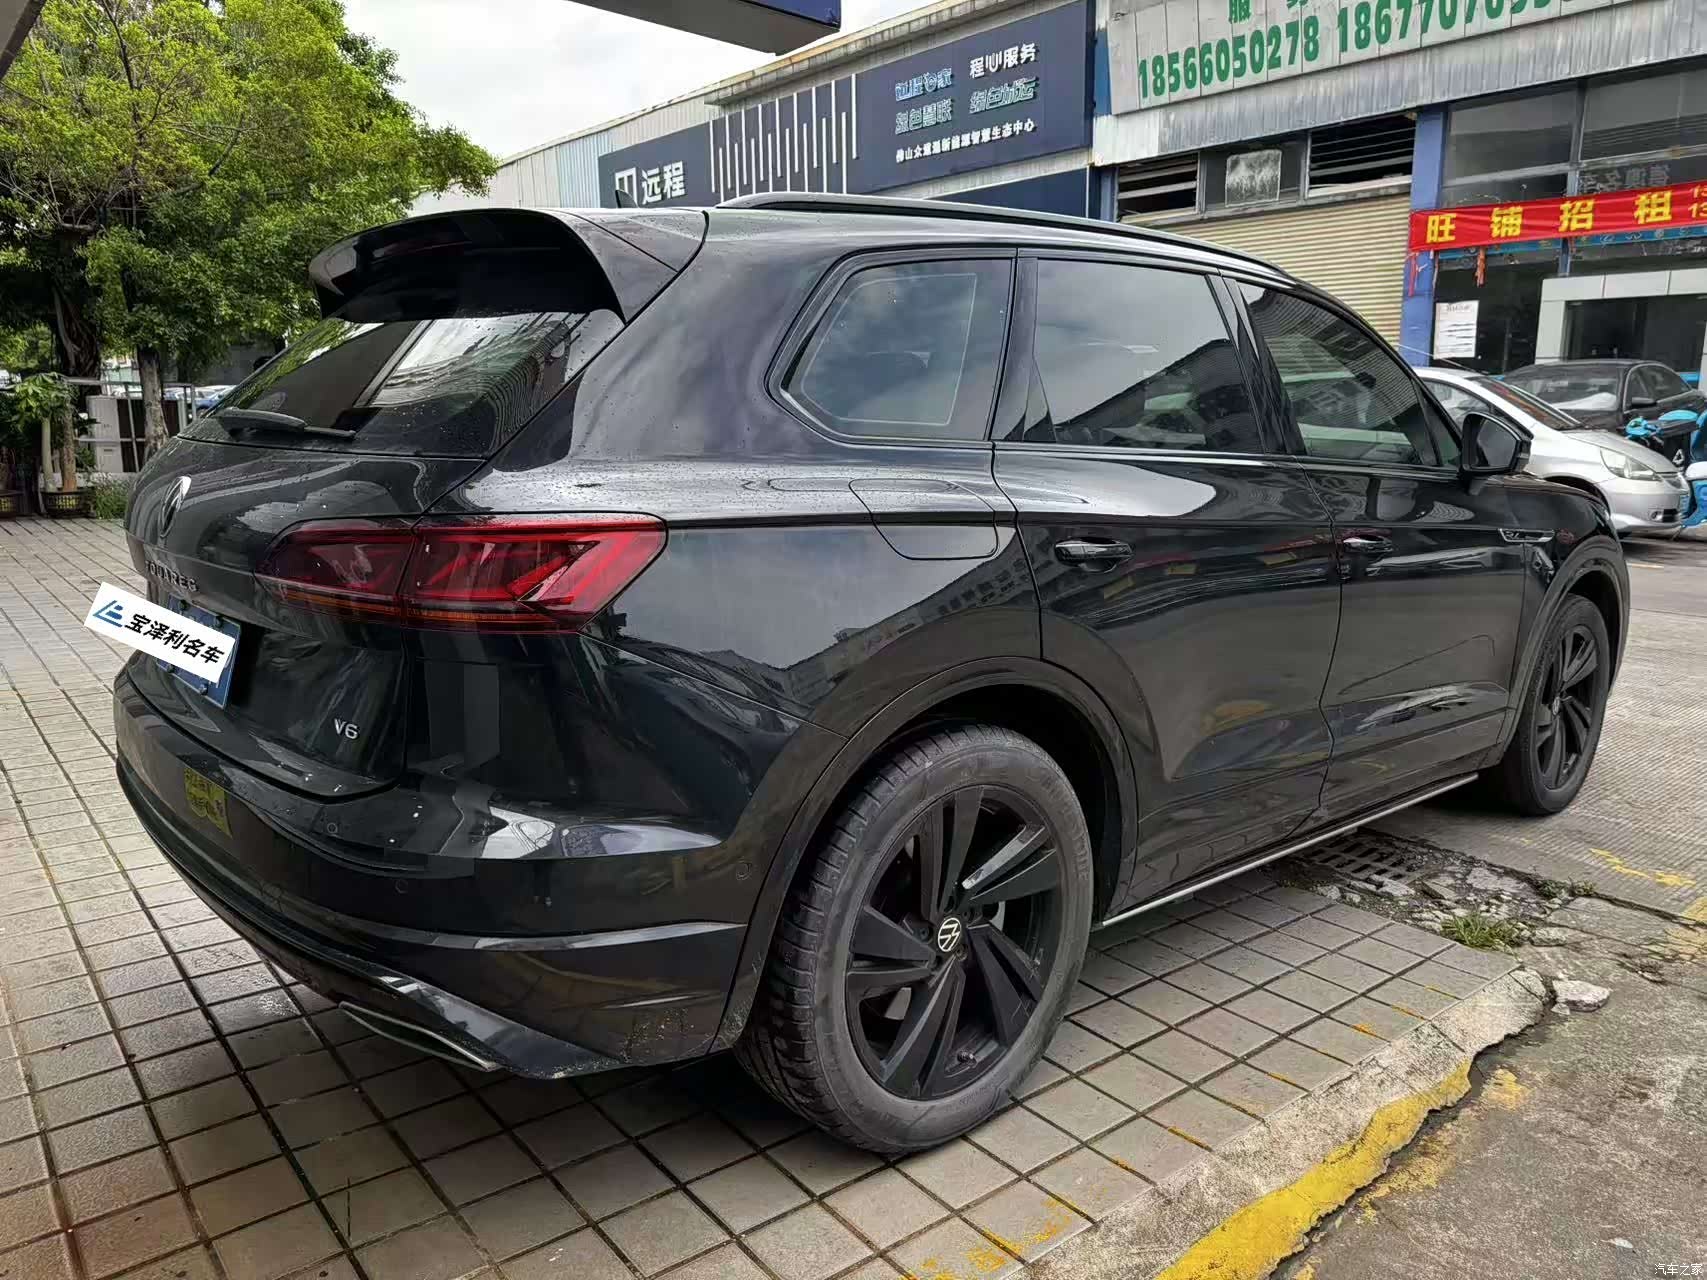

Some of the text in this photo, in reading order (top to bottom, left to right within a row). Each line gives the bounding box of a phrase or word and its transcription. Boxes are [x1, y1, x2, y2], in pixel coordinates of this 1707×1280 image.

[970, 43, 1036, 78] 程心服务
[1138, 0, 1570, 98] 18566050278 186770
[642, 161, 686, 205] 远程
[1426, 191, 1673, 244] 旺铺招租
[334, 718, 360, 740] V6
